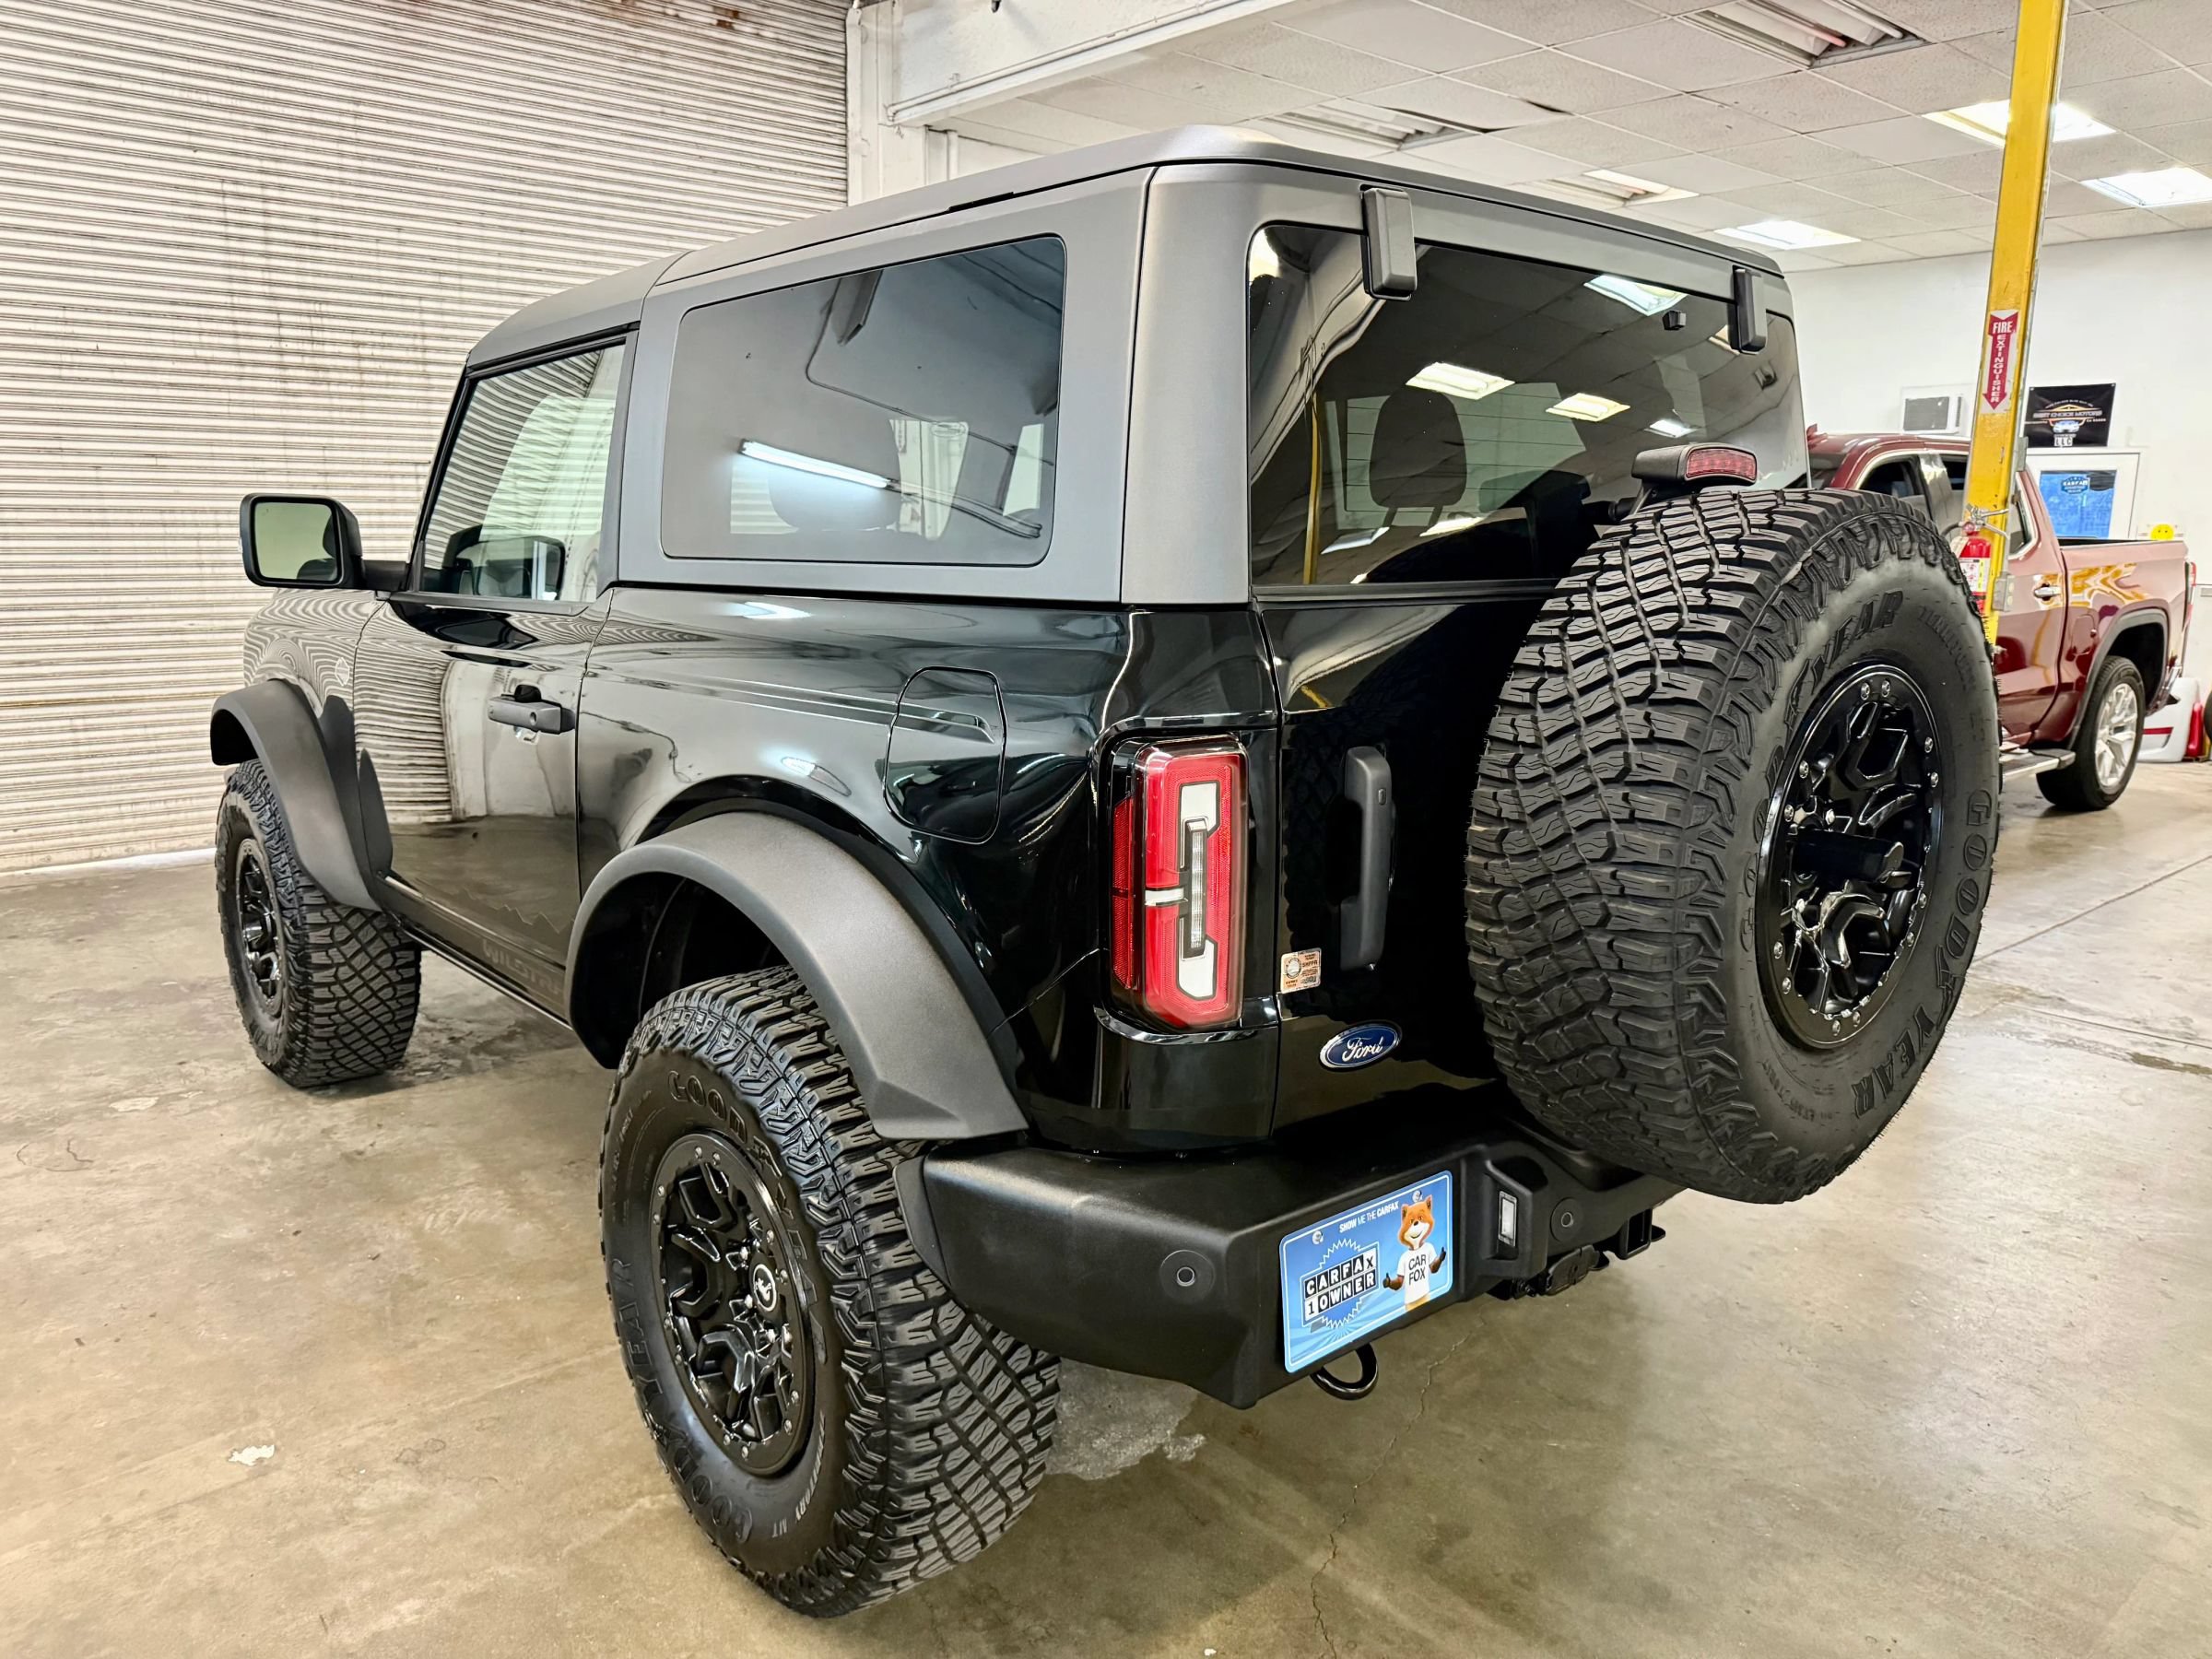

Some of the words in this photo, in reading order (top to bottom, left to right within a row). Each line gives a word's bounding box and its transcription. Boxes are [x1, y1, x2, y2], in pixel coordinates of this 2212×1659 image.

[1993, 321, 2013, 334] FIRE
[1991, 335, 2006, 403] EXTINGUISHER
[1342, 1037, 1383, 1062] Ford
[1339, 1218, 1357, 1233] SHOW
[1358, 1214, 1366, 1226] ME
[1367, 1209, 1376, 1222] THE
[1377, 1200, 1399, 1218] CARFAX
[1408, 1254, 1427, 1270] CAR
[1306, 1255, 1374, 1295] CARFAX
[1409, 1266, 1426, 1285] FOX
